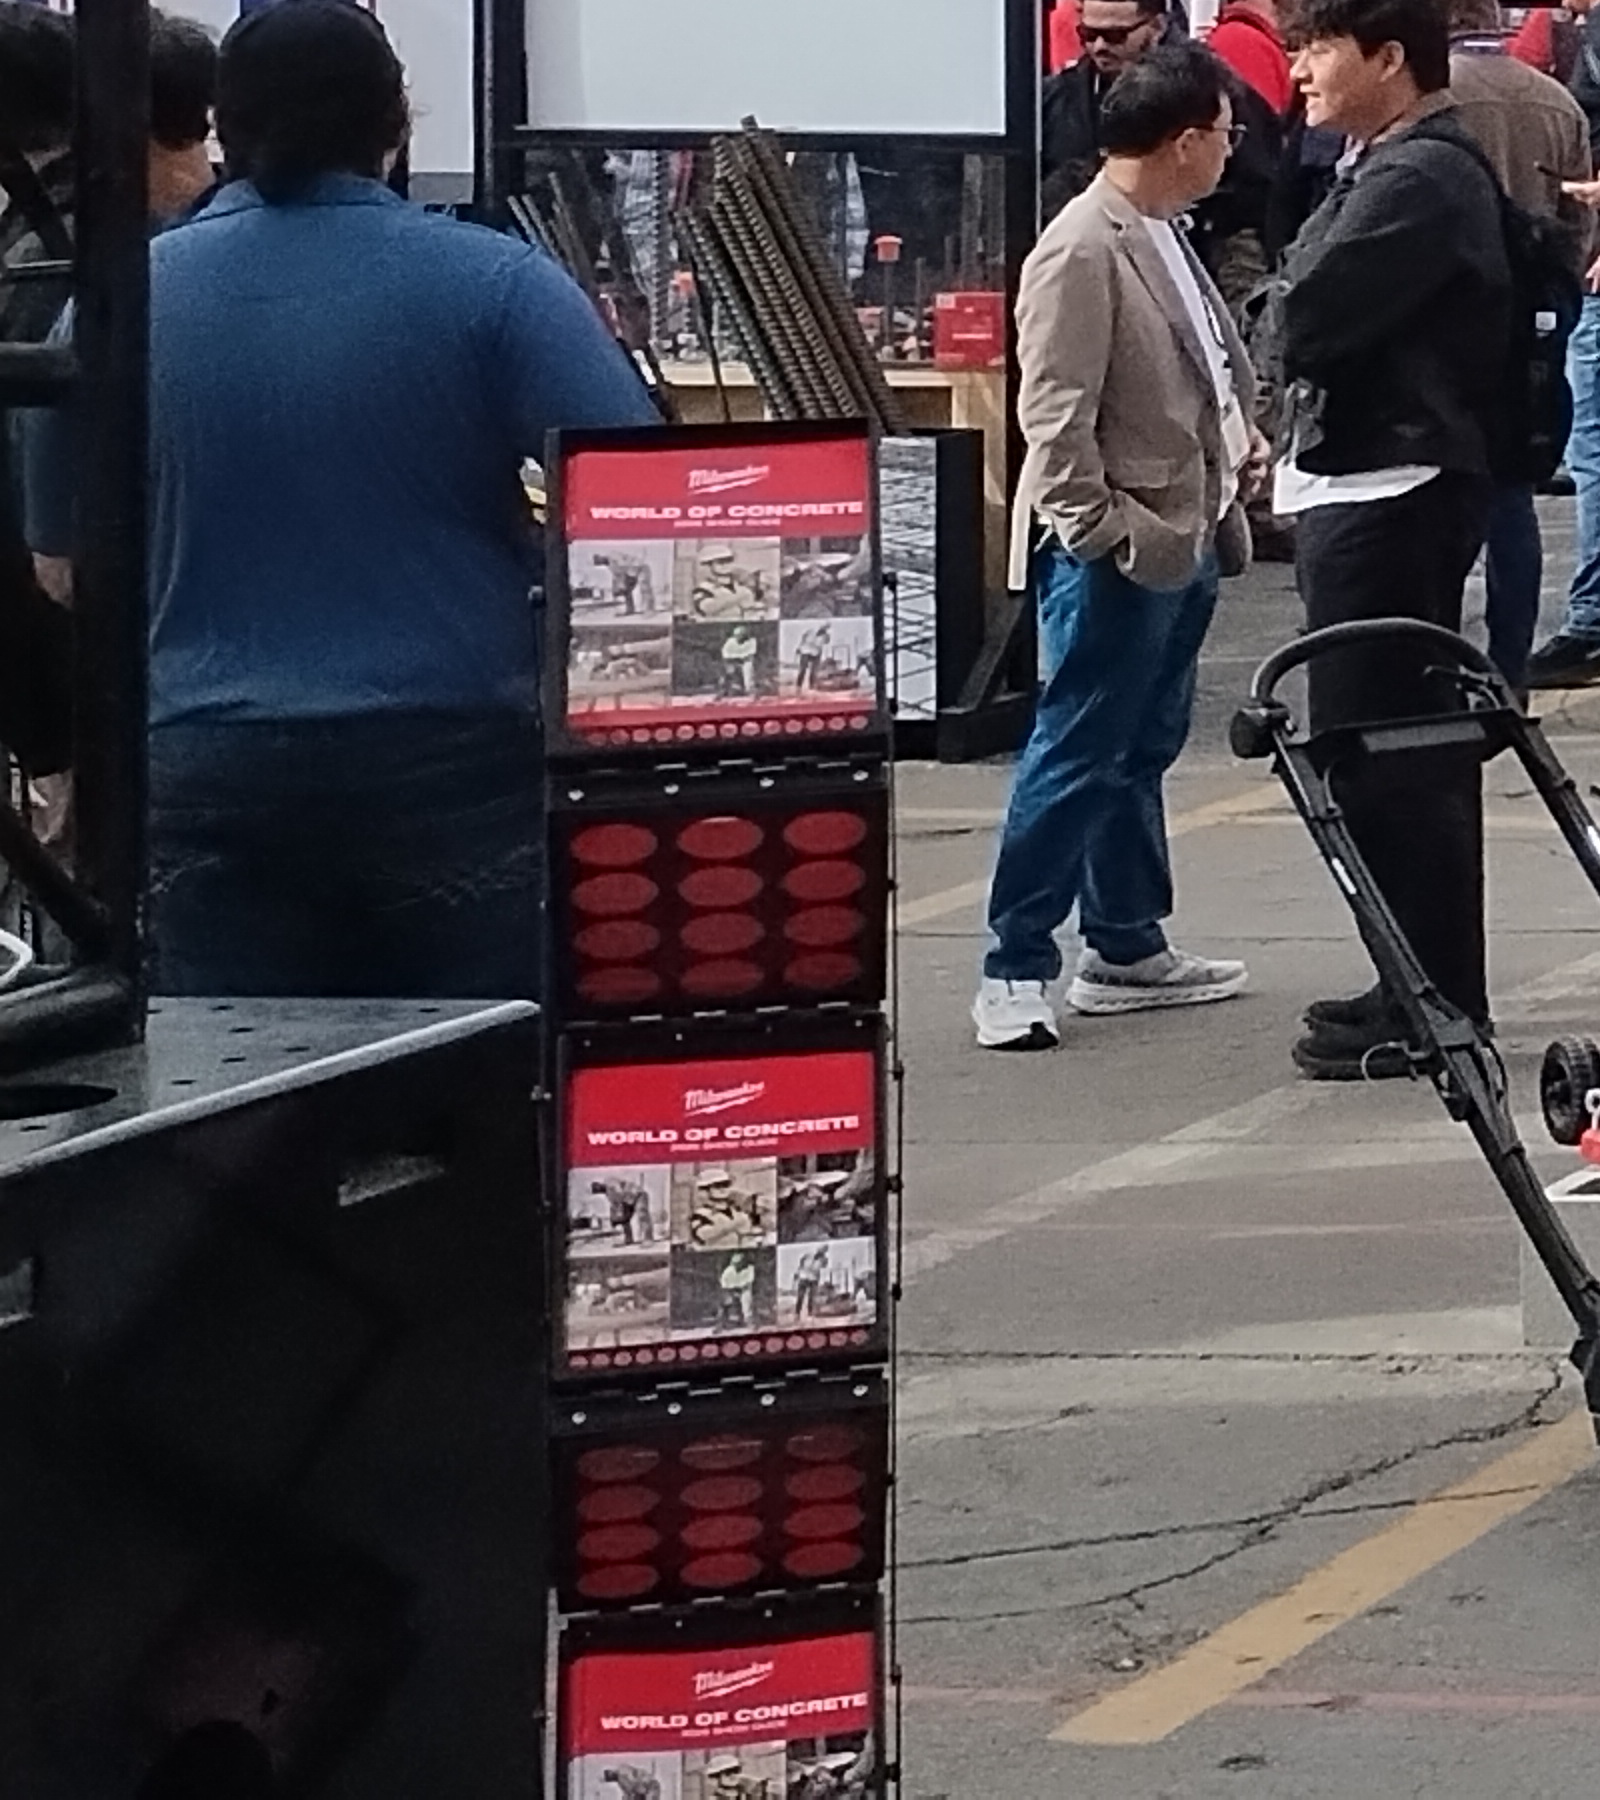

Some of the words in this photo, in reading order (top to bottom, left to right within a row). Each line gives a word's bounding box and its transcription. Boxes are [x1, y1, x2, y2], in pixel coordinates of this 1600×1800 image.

[590, 503, 681, 519] WORLD
[687, 504, 723, 519] OF
[728, 500, 864, 517] CONCRETE
[587, 1131, 679, 1146] WORLD
[686, 1127, 720, 1142] OF
[726, 1115, 860, 1139] CONCRETE
[600, 1714, 689, 1731] WORLD
[696, 1712, 729, 1728] OF
[734, 1691, 868, 1722] CONCRETE
